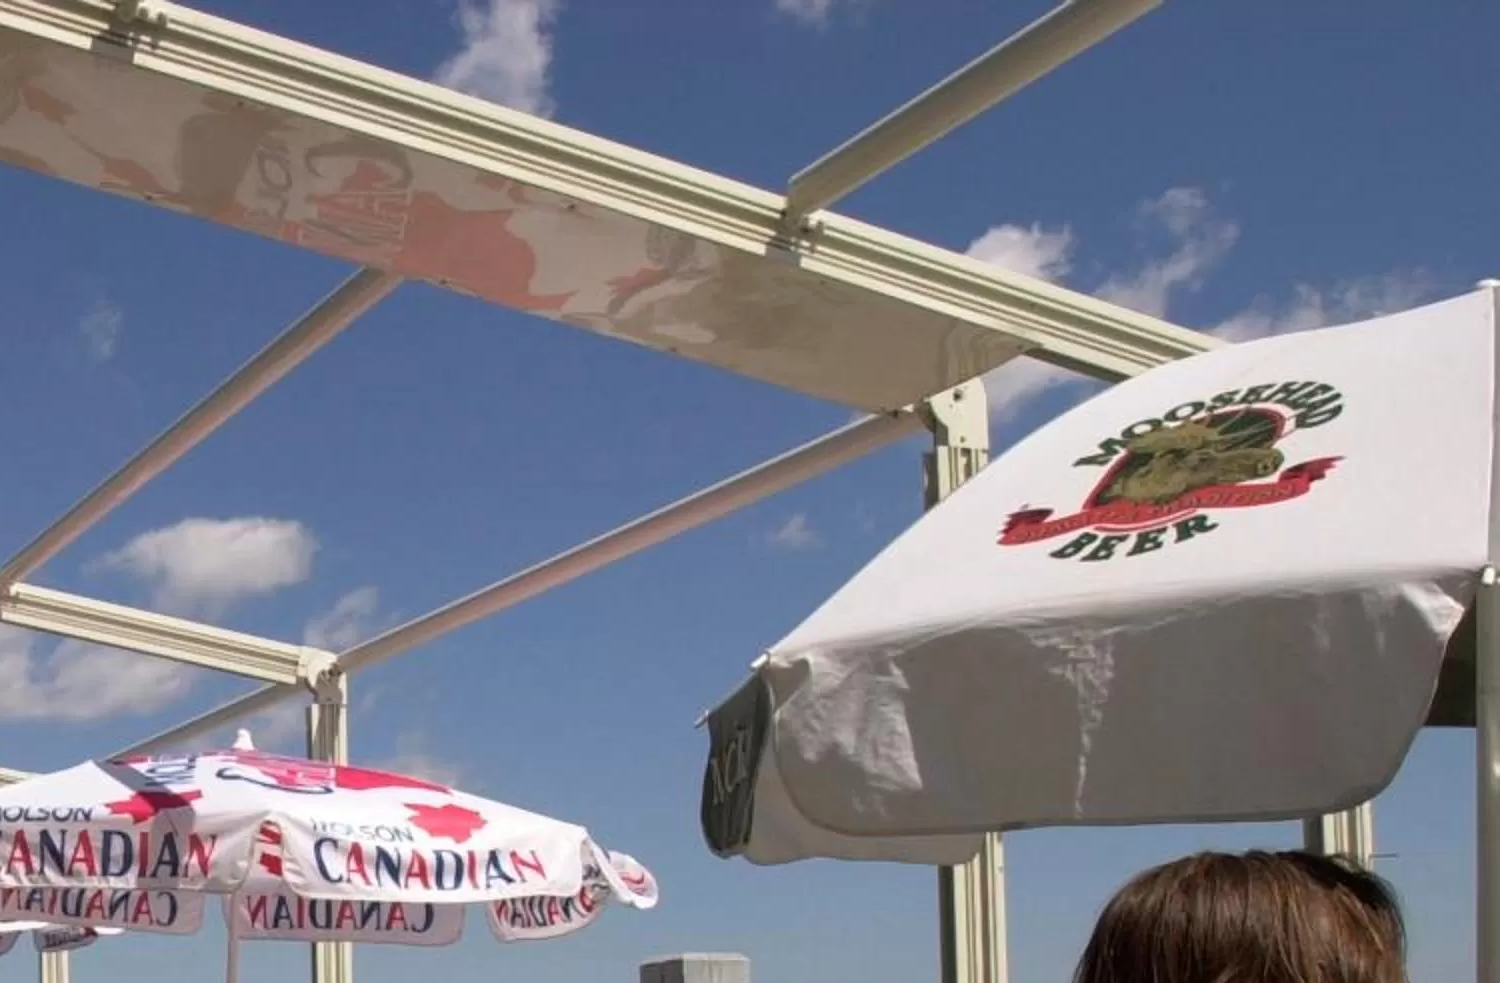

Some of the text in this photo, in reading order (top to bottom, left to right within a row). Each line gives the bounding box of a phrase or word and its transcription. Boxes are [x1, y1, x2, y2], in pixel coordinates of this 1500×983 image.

[1072, 381, 1344, 468] MOOSEHEAD
[1049, 513, 1220, 562] BEER
[313, 838, 547, 891] CANADIAN
